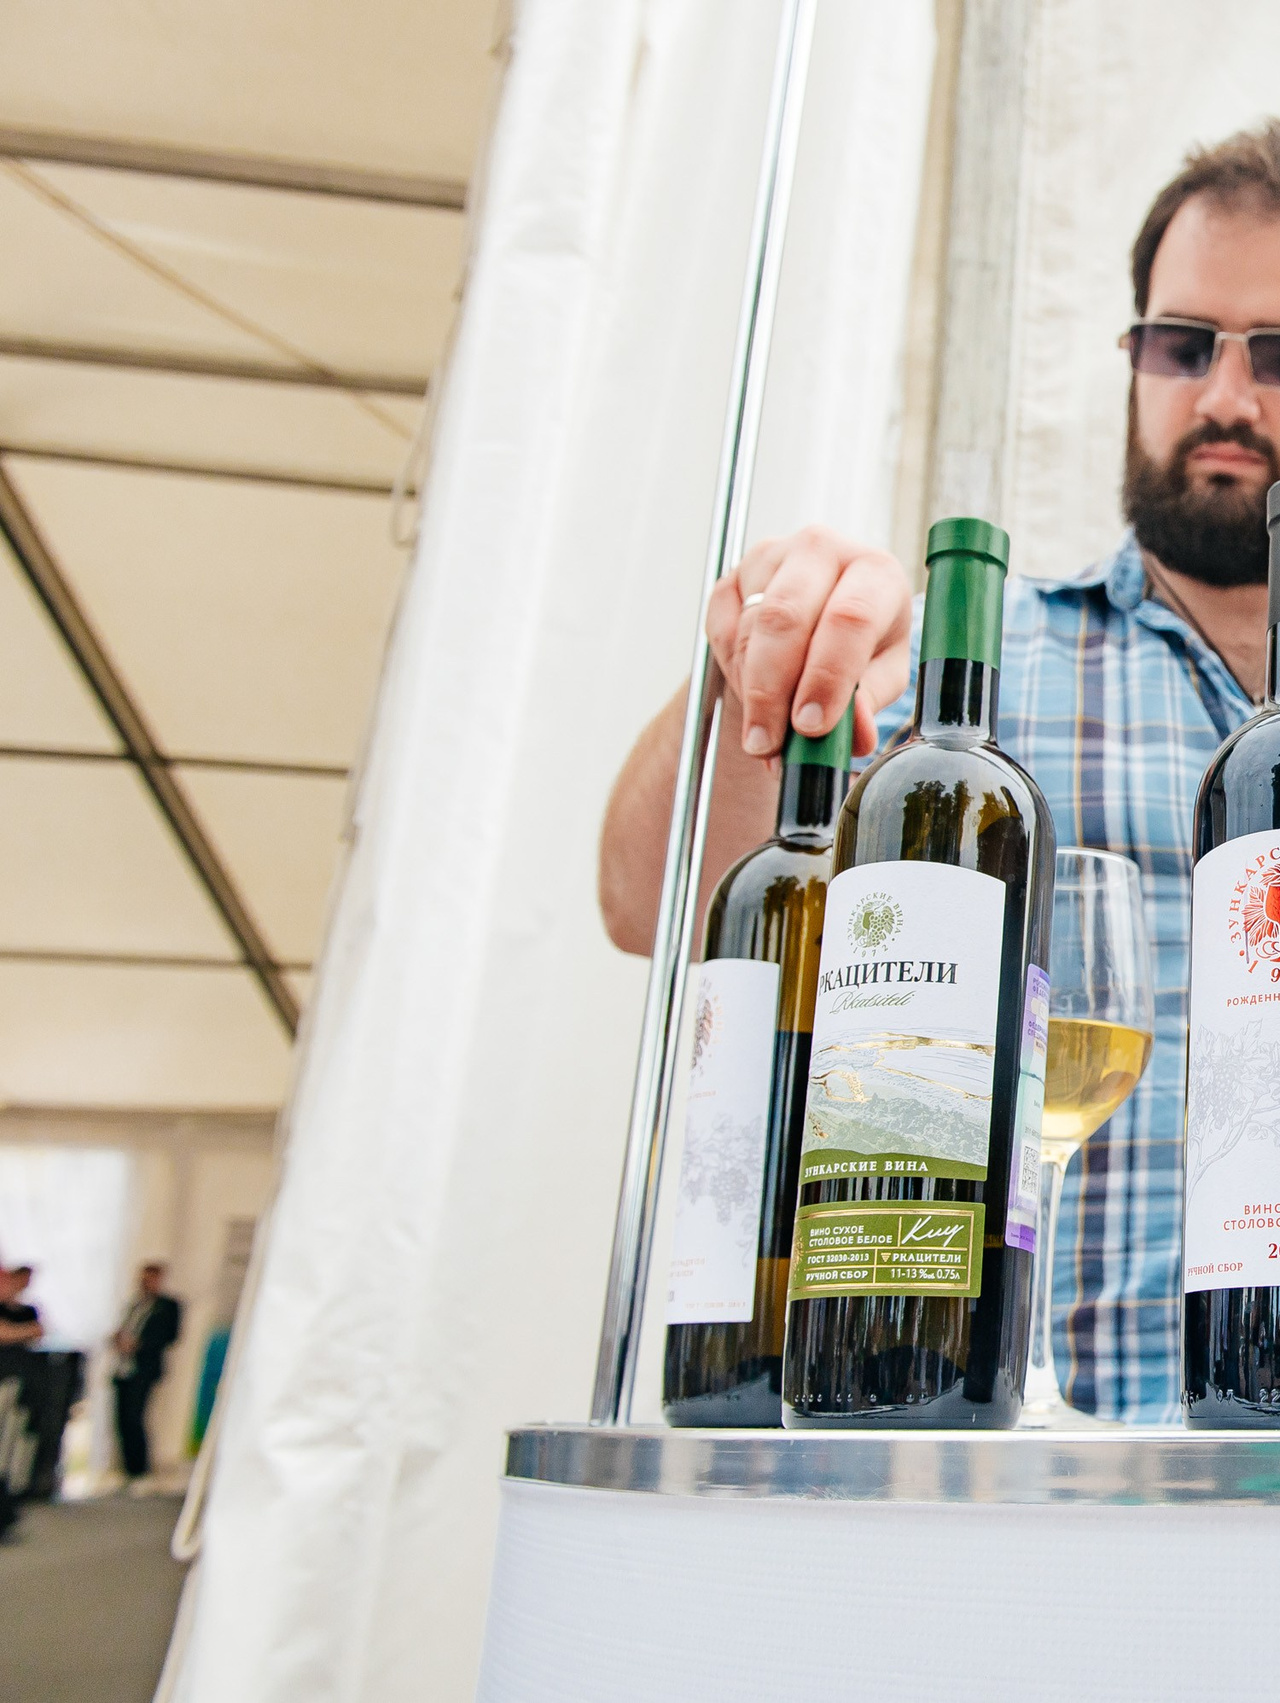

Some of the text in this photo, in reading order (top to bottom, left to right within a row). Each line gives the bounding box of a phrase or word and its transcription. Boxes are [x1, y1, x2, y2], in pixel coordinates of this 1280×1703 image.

[818, 960, 959, 997] РКАЦИТЕЛИ
[804, 1160, 929, 1178] ЗУНКАРСКИЕ ВИНА
[810, 1225, 865, 1237] ВИНО СУХОЕ
[809, 1234, 893, 1248] СТОЛОВОЕ БЕЛОЕ
[807, 1253, 870, 1265] ГОСТ 32030-2013
[892, 1252, 962, 1264] РКАЦИТЕЛИ
[891, 1268, 917, 1279] 11-13
[1217, 1262, 1244, 1273] СБОР
[806, 1269, 869, 1282] РУЧНОЙ СБОР
